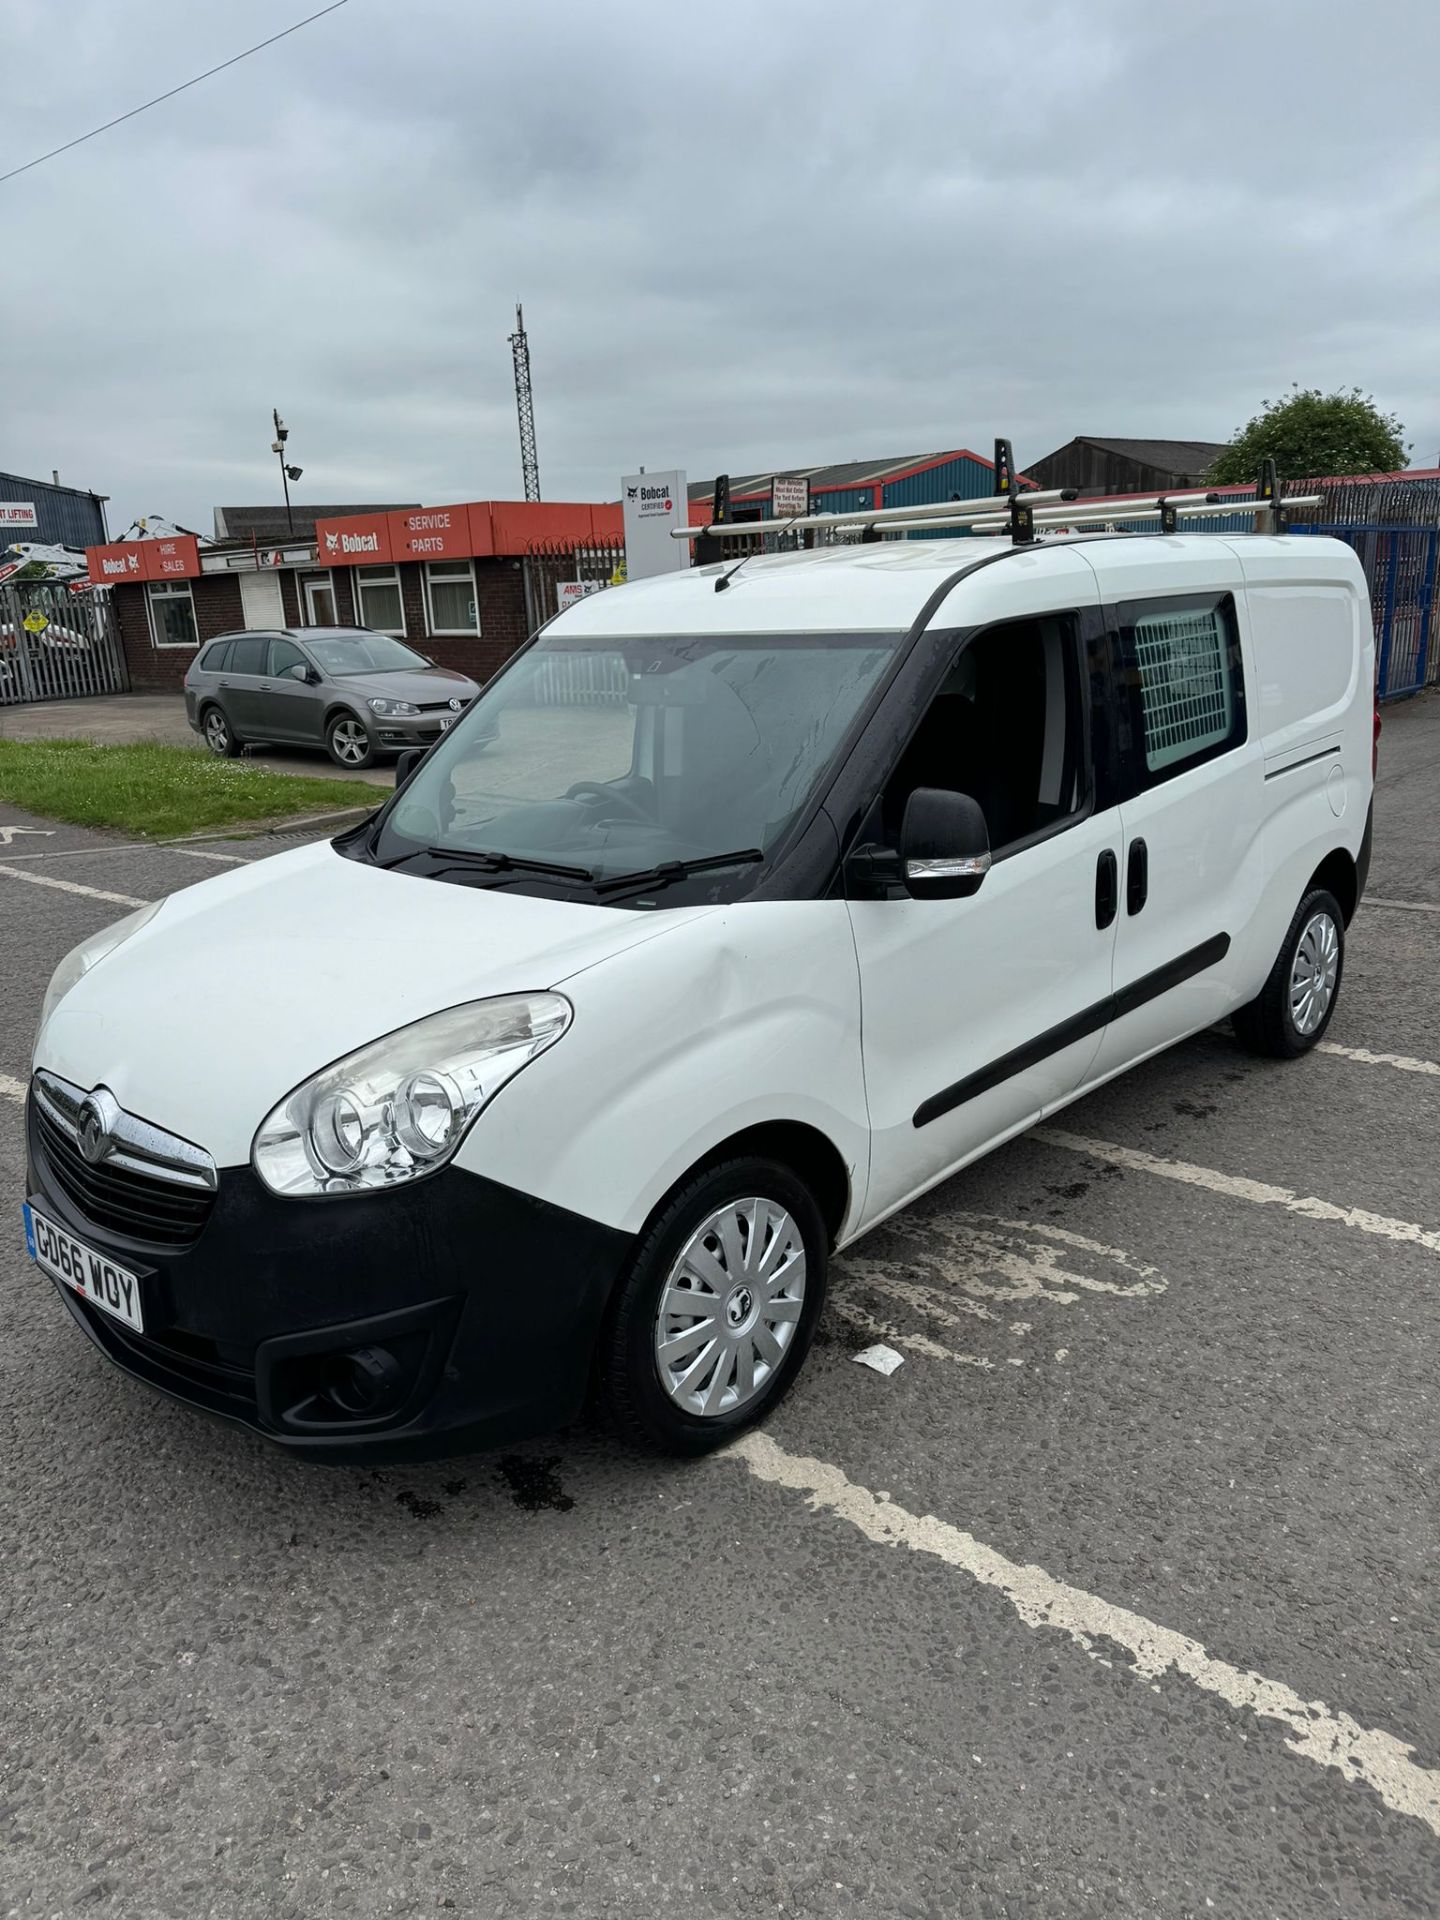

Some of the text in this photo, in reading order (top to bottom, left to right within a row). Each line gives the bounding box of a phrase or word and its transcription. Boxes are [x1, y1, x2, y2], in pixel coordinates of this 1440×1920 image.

[640, 485, 669, 500] Bobcat
[641, 502, 664, 510] CERTIFIED
[7, 509, 33, 519] LIFTING
[409, 513, 451, 531] SERVICE
[159, 543, 176, 555] HIRE
[341, 532, 379, 553] Bobcat
[411, 537, 444, 552] PARTS
[102, 557, 127, 574] Bobcat
[163, 560, 185, 572] SALES
